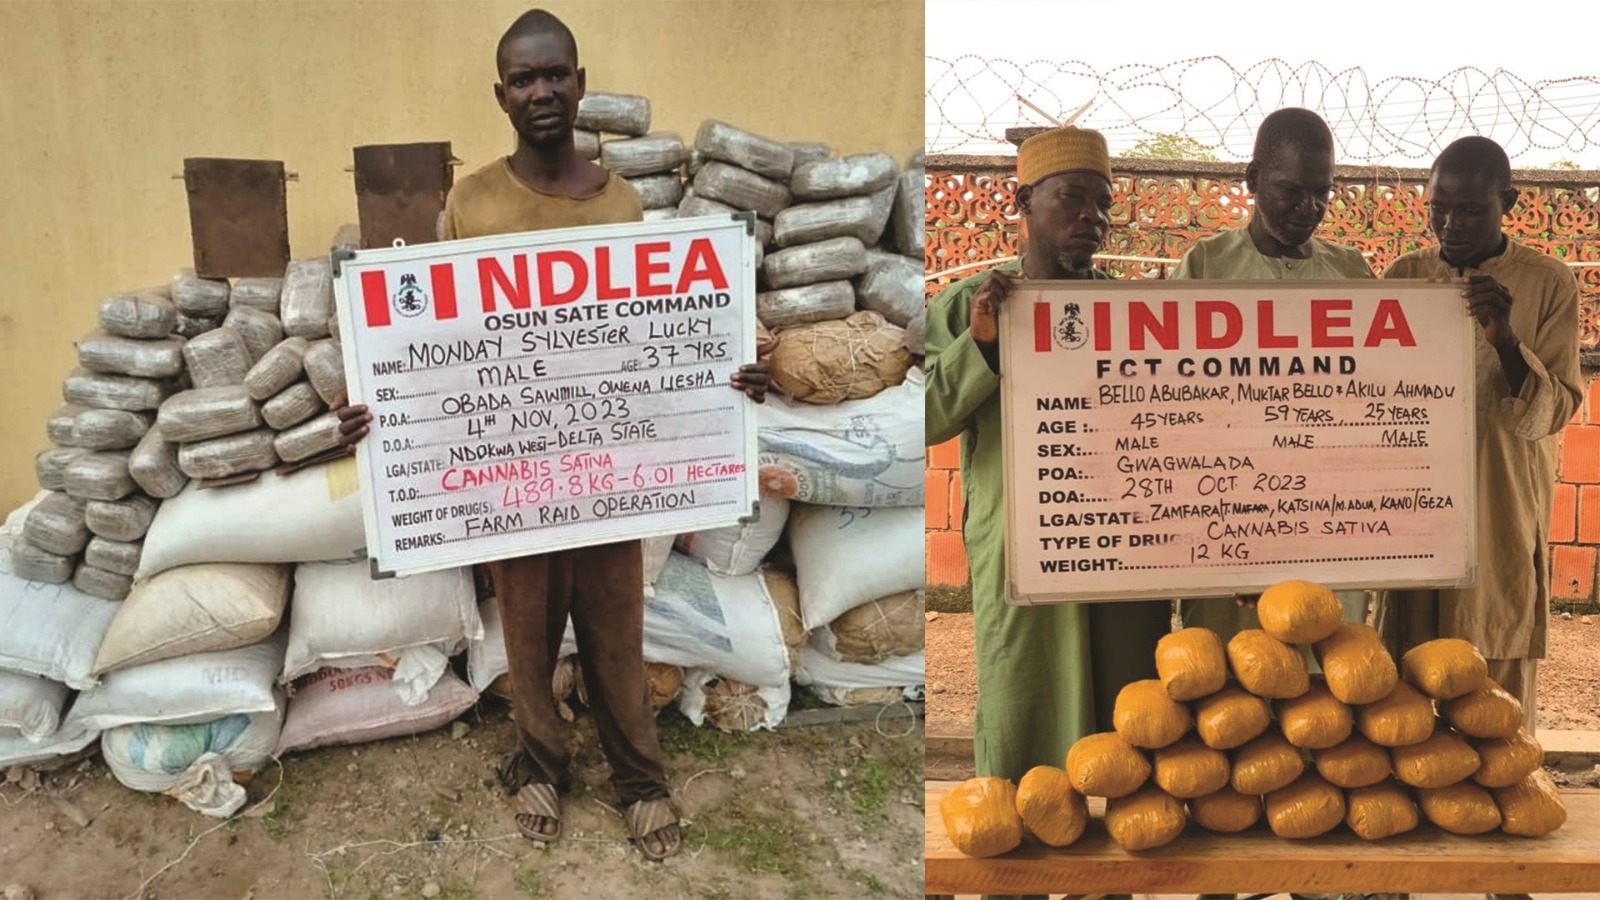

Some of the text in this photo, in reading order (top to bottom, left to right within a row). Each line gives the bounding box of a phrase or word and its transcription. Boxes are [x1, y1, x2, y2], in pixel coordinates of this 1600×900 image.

[477, 238, 729, 313] NDLEA
[484, 292, 731, 331] OSUN SATE COMMAND
[1129, 300, 1416, 350] NDLEA
[408, 335, 502, 369] MONDAY
[521, 323, 631, 352] SYLVESTER
[477, 360, 547, 387] MALE
[643, 345, 679, 368] 37
[684, 341, 727, 360] YRS
[1096, 355, 1357, 379] FCT COMMAND
[442, 393, 512, 415] OBADA
[520, 385, 596, 405] SAWMILL,
[599, 379, 650, 395] OWENA
[1099, 384, 1145, 405] BELLO
[1149, 383, 1234, 405] ABUBAKAR,
[1292, 382, 1333, 400] BELLO
[1345, 379, 1386, 399] AKILU
[1393, 380, 1455, 400] AHMADU
[565, 397, 630, 426] 2023
[449, 443, 515, 466] NDOKWA
[610, 419, 657, 441] STATE
[1037, 429, 1426, 457] SEX: MALE MALE MALE
[441, 459, 550, 492] CANNABIS
[1038, 455, 1254, 480] POA: GWAGWALADA
[1039, 491, 1085, 504] DOA:
[1121, 477, 1173, 499] 28TH
[1253, 472, 1306, 492] 2023
[391, 509, 433, 528] WEIGHT
[436, 506, 449, 521] OF
[465, 512, 523, 537] FARM
[539, 504, 580, 524] RAID
[592, 489, 696, 519] OPERATION
[1040, 536, 1091, 550] TYPE
[1096, 535, 1122, 549] OF
[1207, 520, 1309, 540] CANNABIS
[1320, 520, 1391, 536] SATIVA
[1040, 543, 1250, 573] WEIGHT: 12 KG
